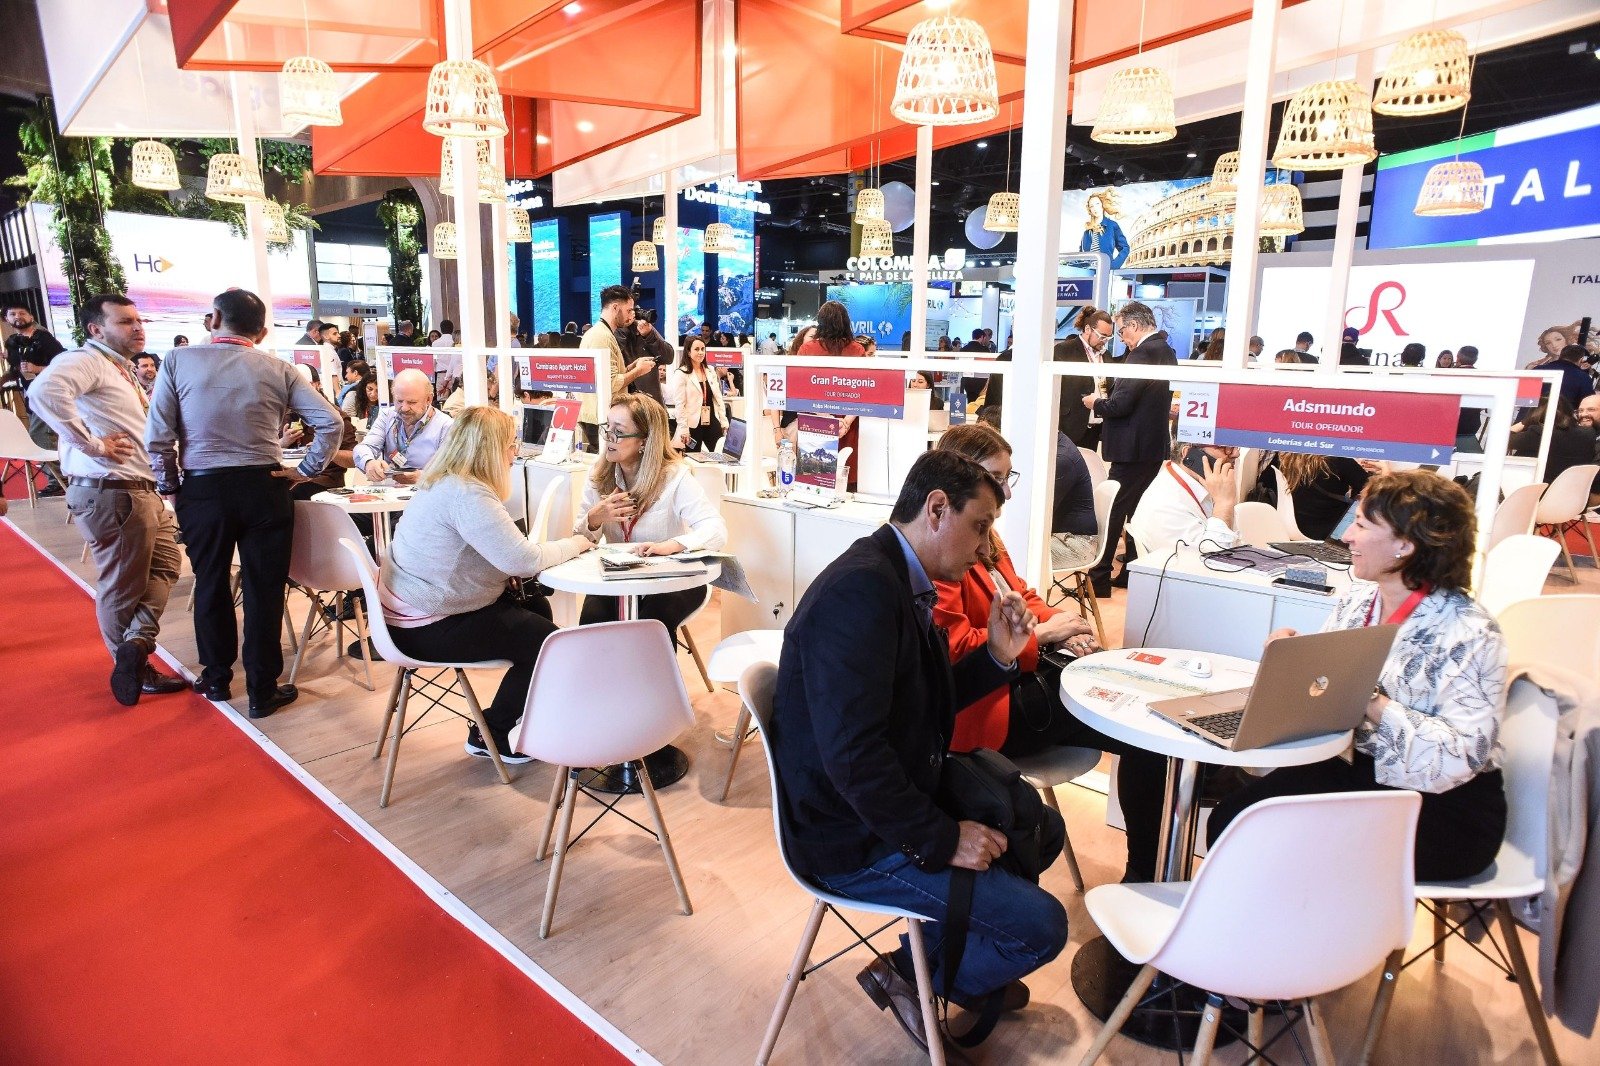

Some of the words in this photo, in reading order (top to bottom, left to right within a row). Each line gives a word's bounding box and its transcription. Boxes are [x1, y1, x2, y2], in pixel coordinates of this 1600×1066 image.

[1483, 159, 1592, 210] TAL
[846, 255, 941, 271] COLOMA
[860, 269, 882, 280] PAÍS
[886, 272, 899, 280] DE
[928, 271, 964, 279] ELLEZA
[521, 366, 529, 376] 23
[769, 379, 784, 392] 22
[810, 374, 830, 385] Gran
[832, 376, 876, 388] Patagonia
[1186, 400, 1209, 418] 21
[1283, 399, 1376, 417] Adsmundo
[1291, 421, 1314, 430] TOUR
[1315, 423, 1364, 434] OPERADOR
[1202, 430, 1212, 439] 14
[1268, 437, 1302, 446] Loberías
[1304, 440, 1318, 448] del
[1320, 441, 1334, 449] Sur
